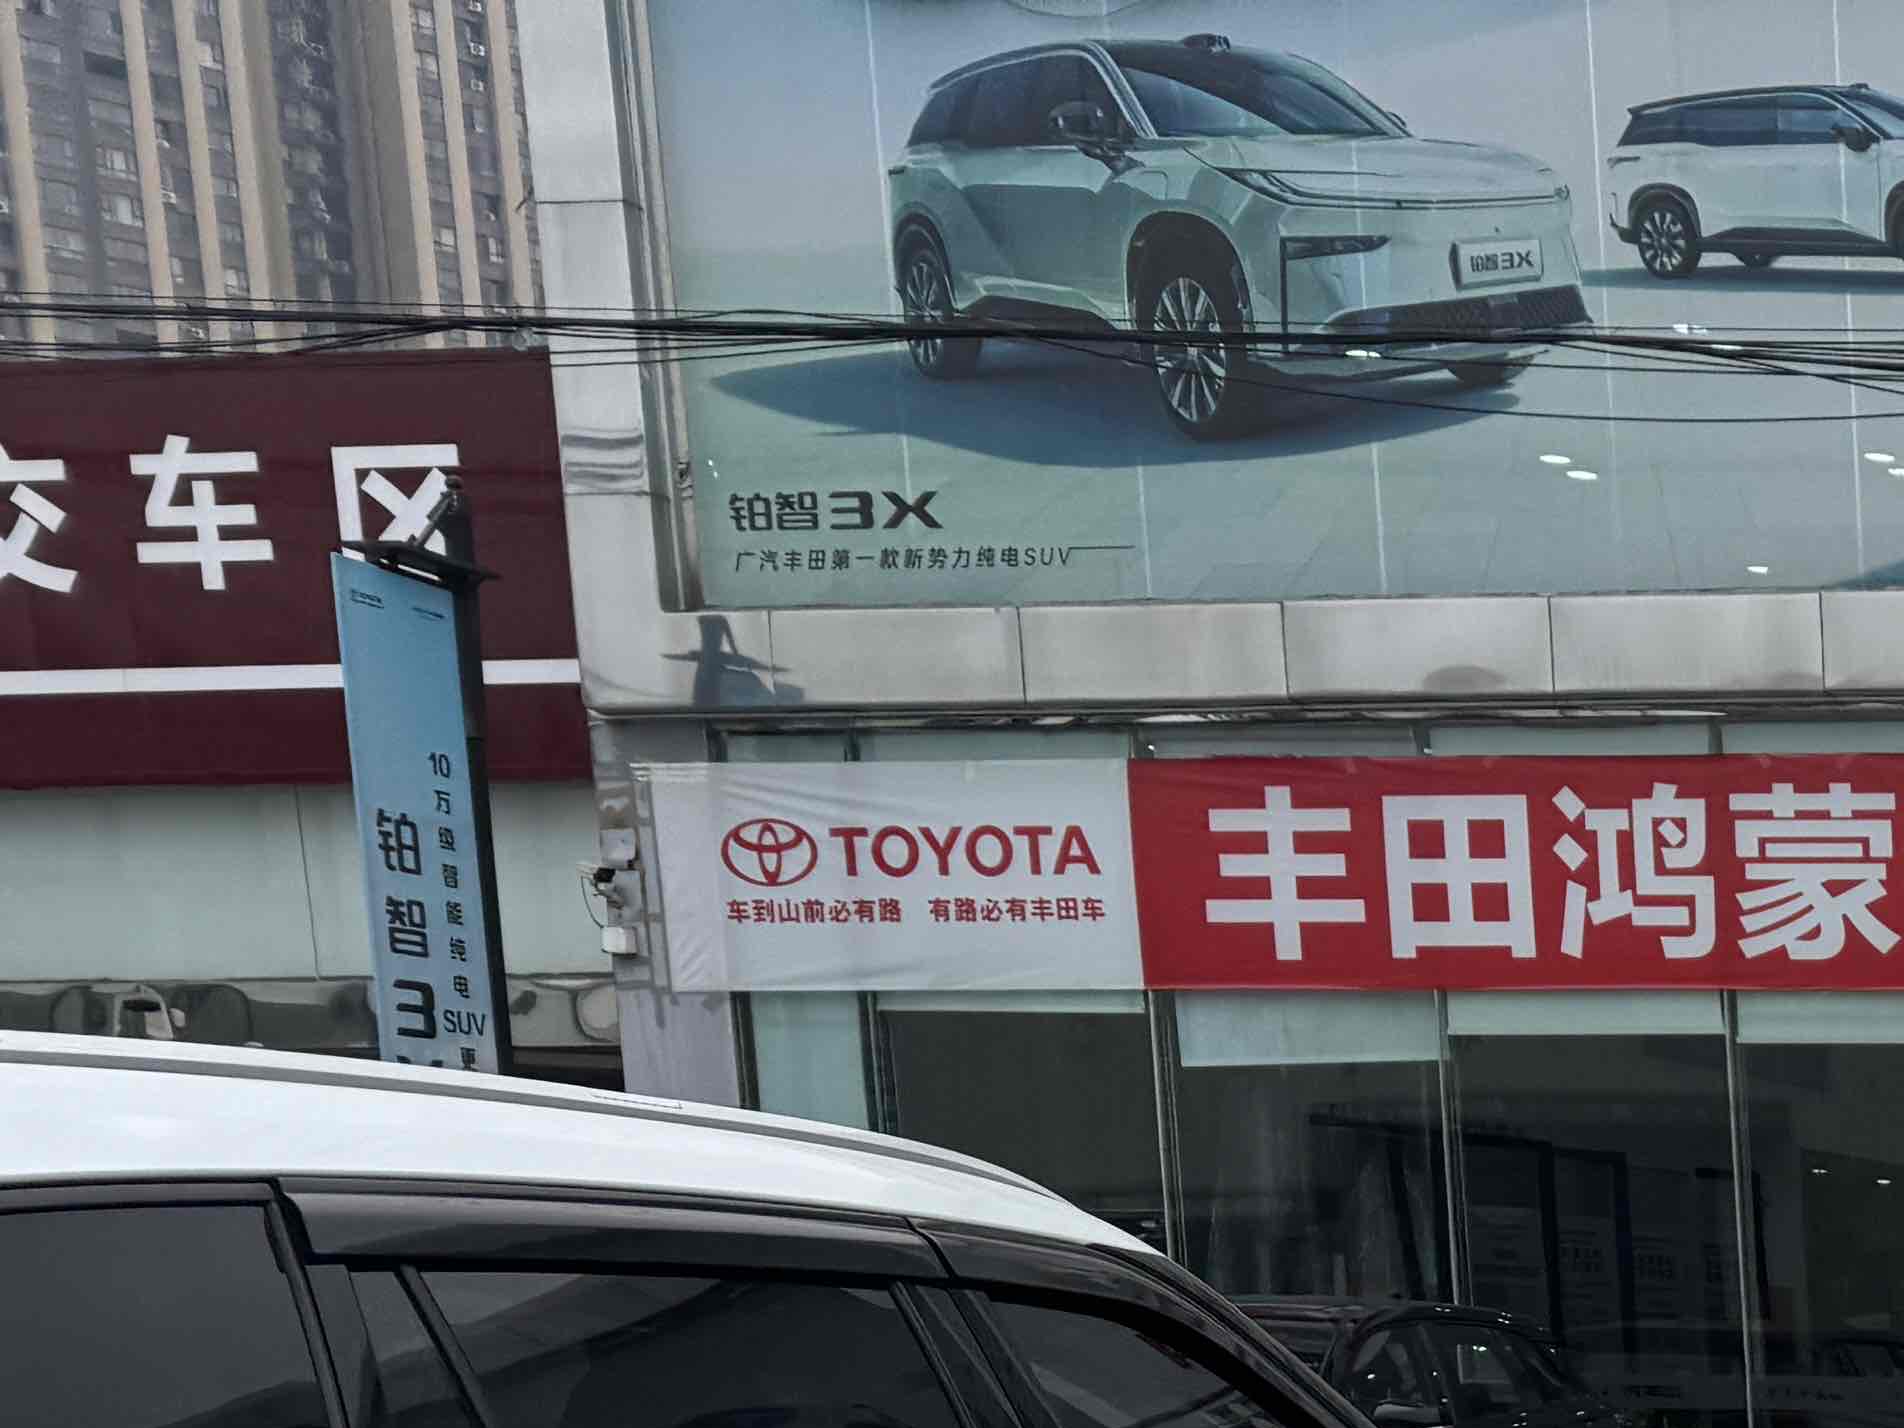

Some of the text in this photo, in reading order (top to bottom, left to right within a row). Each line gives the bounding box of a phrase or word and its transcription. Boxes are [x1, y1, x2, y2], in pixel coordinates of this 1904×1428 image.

[729, 489, 944, 532] 铂智3X
[734, 546, 1072, 574] 广汽丰田第一款新势力纯电SUV
[828, 824, 1102, 877] TOYOTA
[726, 897, 1106, 924] 车到山前必有路 有路必有丰田车
[377, 807, 443, 1067] 铂智3
